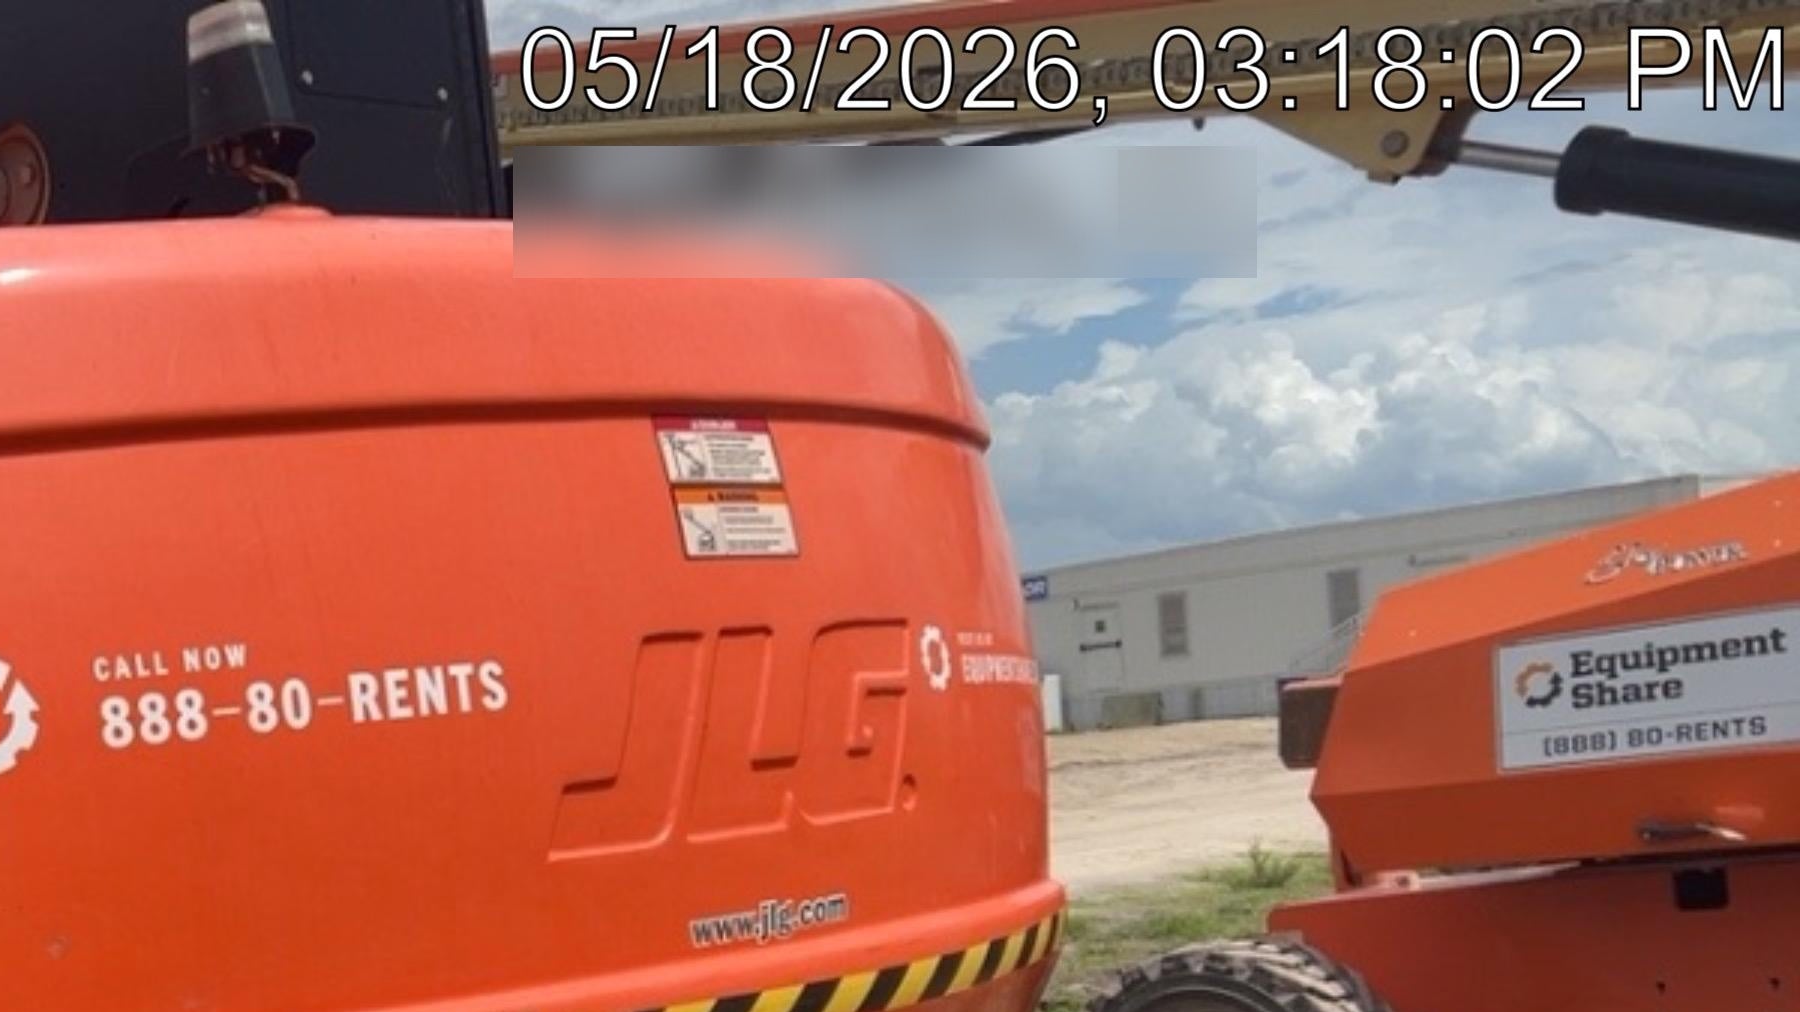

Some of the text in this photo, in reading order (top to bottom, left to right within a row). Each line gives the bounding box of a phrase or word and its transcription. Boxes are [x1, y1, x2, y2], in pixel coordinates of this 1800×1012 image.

[92, 643, 248, 682] CALL NOW
[1569, 626, 1788, 680] Equipment
[99, 659, 509, 750] 888-80-RENTS
[1570, 677, 1684, 709] Share
[1627, 715, 1767, 747] 80-RENTS
[689, 893, 848, 948] www.jlg.com
